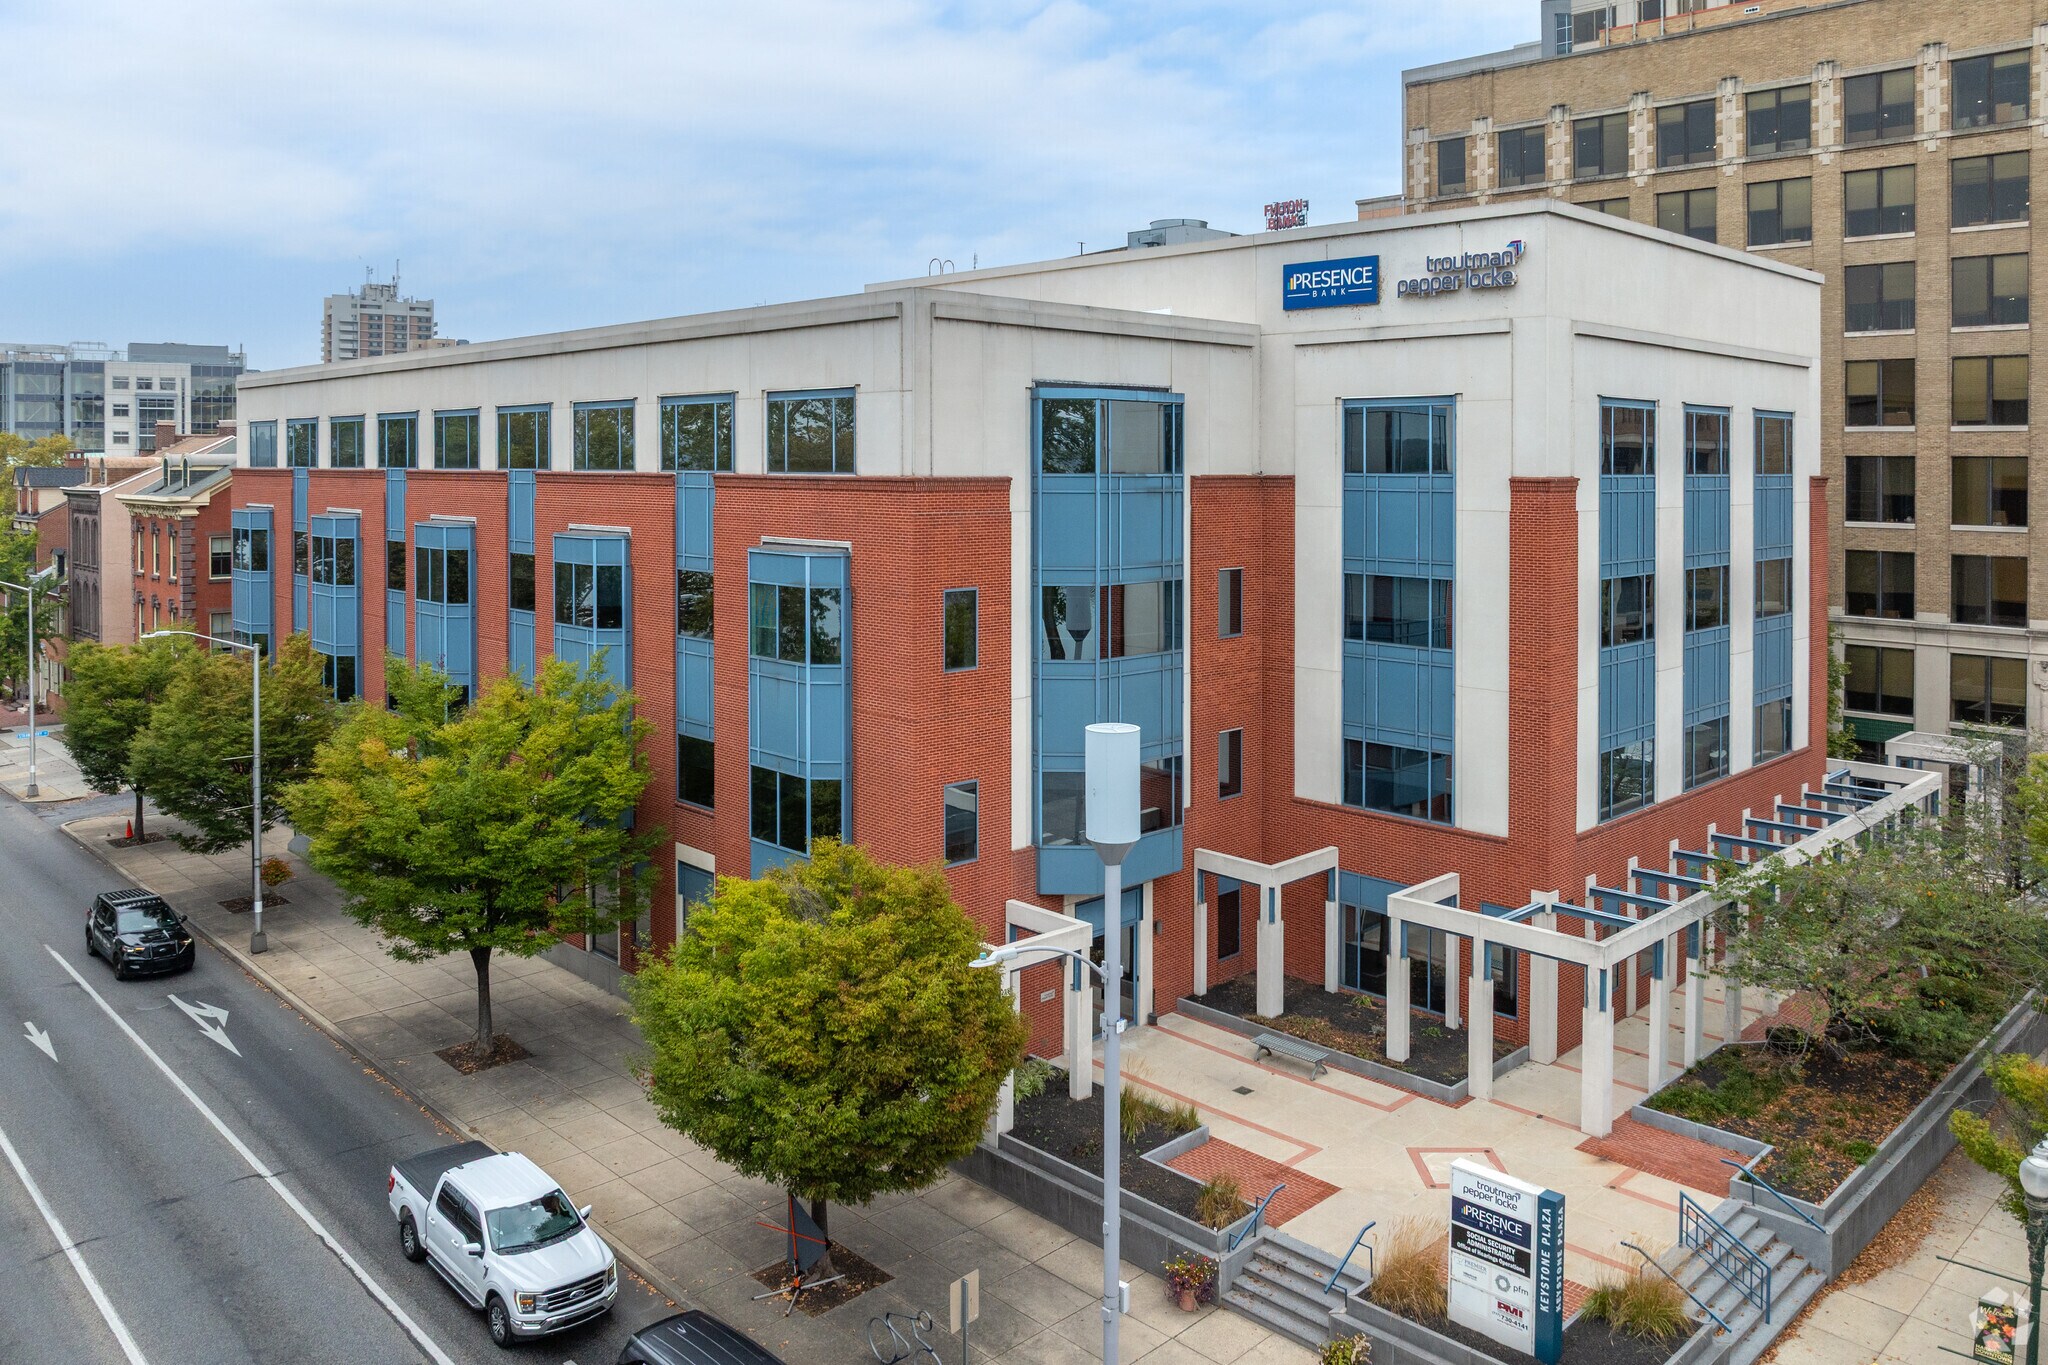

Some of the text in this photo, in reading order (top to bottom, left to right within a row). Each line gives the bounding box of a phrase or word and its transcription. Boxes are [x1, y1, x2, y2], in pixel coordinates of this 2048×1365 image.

[1264, 199, 1302, 216] FULTON
[1267, 215, 1298, 230] BANK
[1426, 249, 1515, 272] troutman
[1293, 266, 1373, 290] PRESENCE
[1397, 268, 1515, 298] pepper locke
[1312, 287, 1347, 298] BANK
[1463, 1186, 1518, 1211] pepper locke
[1476, 1181, 1518, 1203] troutman
[1466, 1204, 1523, 1237] PRESENCE
[1479, 1222, 1504, 1235] BANK
[1466, 1231, 1516, 1255] SOCIAL SECURITY
[1466, 1239, 1515, 1262] ADMINISTRATION
[1456, 1242, 1471, 1252] Office
[1477, 1248, 1498, 1263] Hearings
[1498, 1257, 1526, 1274] Operations
[1539, 1208, 1551, 1313] KEYSTONE PLAZA
[1513, 1285, 1529, 1297] pfm
[1555, 1249, 1563, 1313] KEYSTONE
[1497, 1300, 1523, 1319] PMI
[1501, 1314, 1528, 1331] 730-4141
[1975, 1348, 2012, 1364] DOWNTOWN
